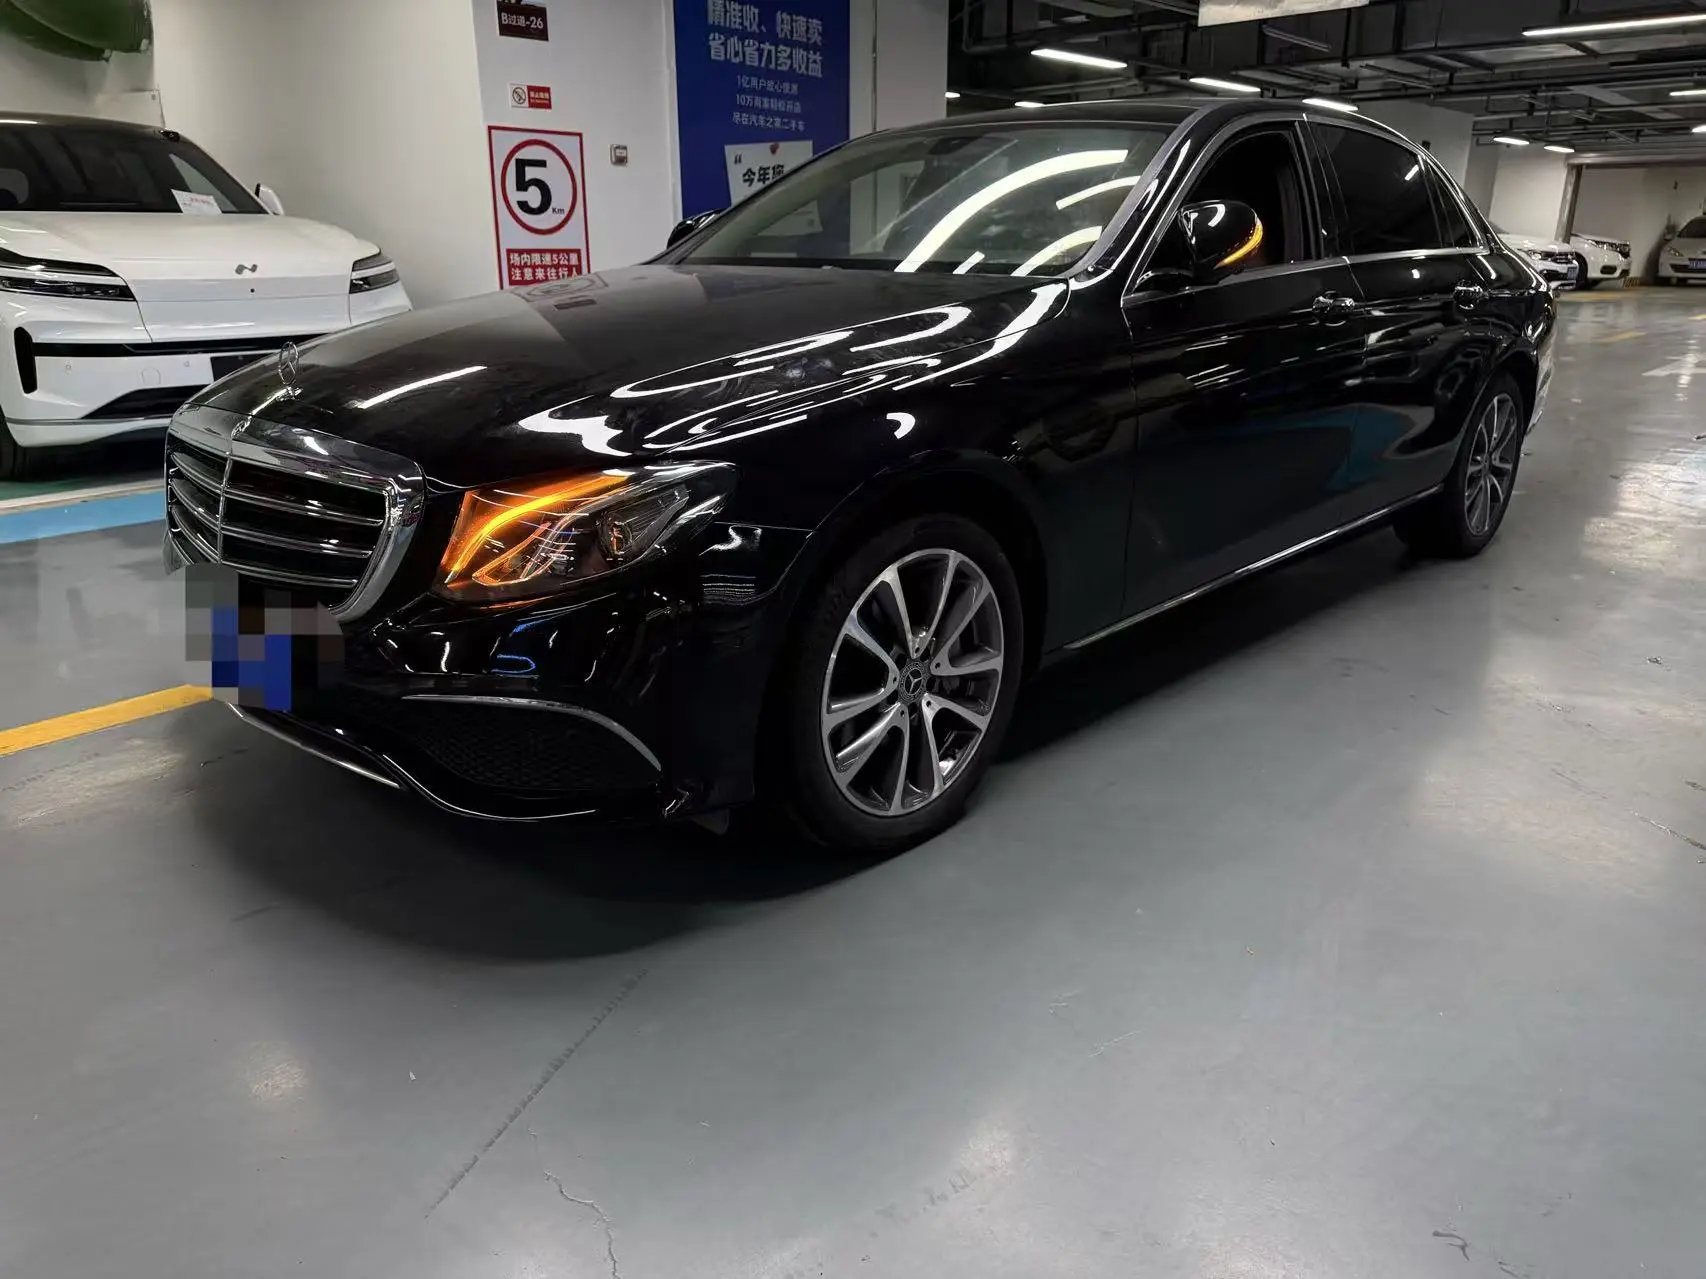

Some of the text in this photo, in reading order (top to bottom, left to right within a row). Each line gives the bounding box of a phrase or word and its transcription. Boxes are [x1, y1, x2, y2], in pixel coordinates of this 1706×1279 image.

[708, 32, 823, 78] 省心省力多收益
[515, 158, 552, 216] 5
[510, 252, 579, 266] 场内限速5公里
[511, 266, 579, 281] 注意来往行人
